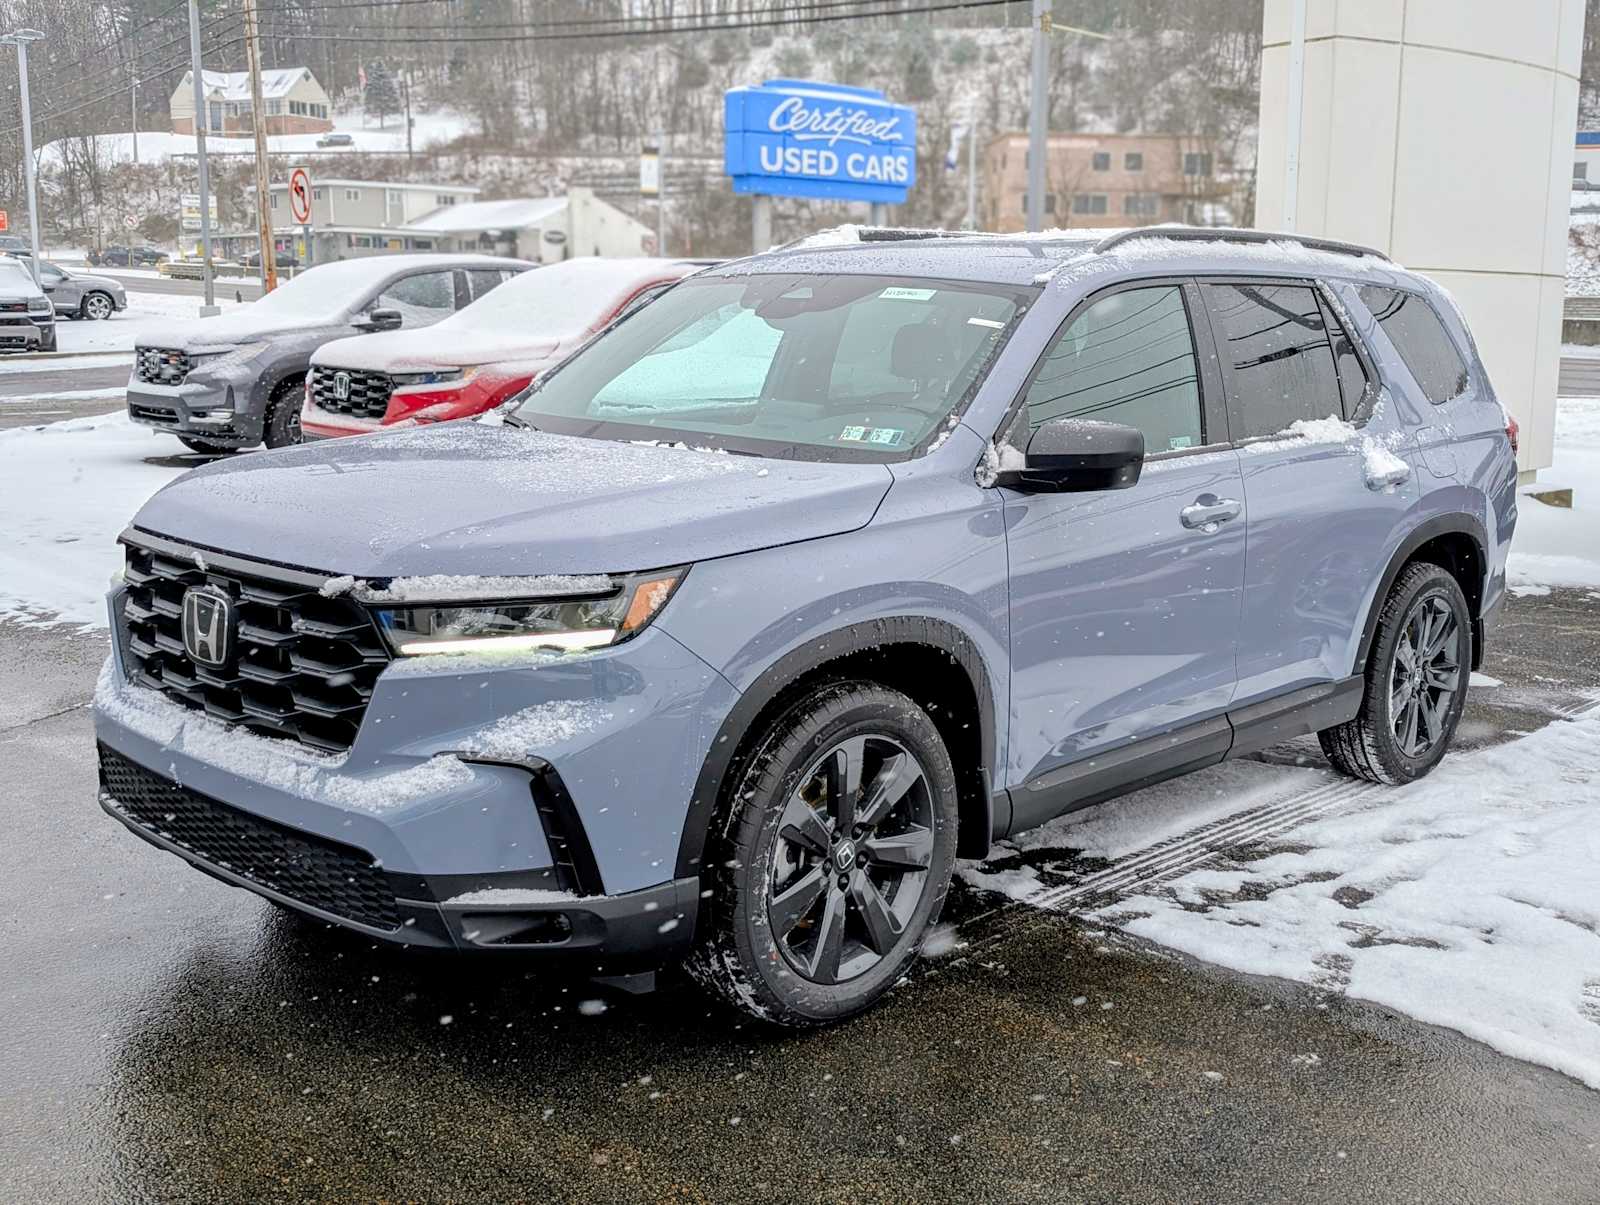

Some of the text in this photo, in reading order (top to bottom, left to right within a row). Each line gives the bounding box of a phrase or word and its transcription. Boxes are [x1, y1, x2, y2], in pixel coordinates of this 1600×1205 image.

[769, 98, 902, 145] Certified
[761, 146, 907, 182] USED CARS
